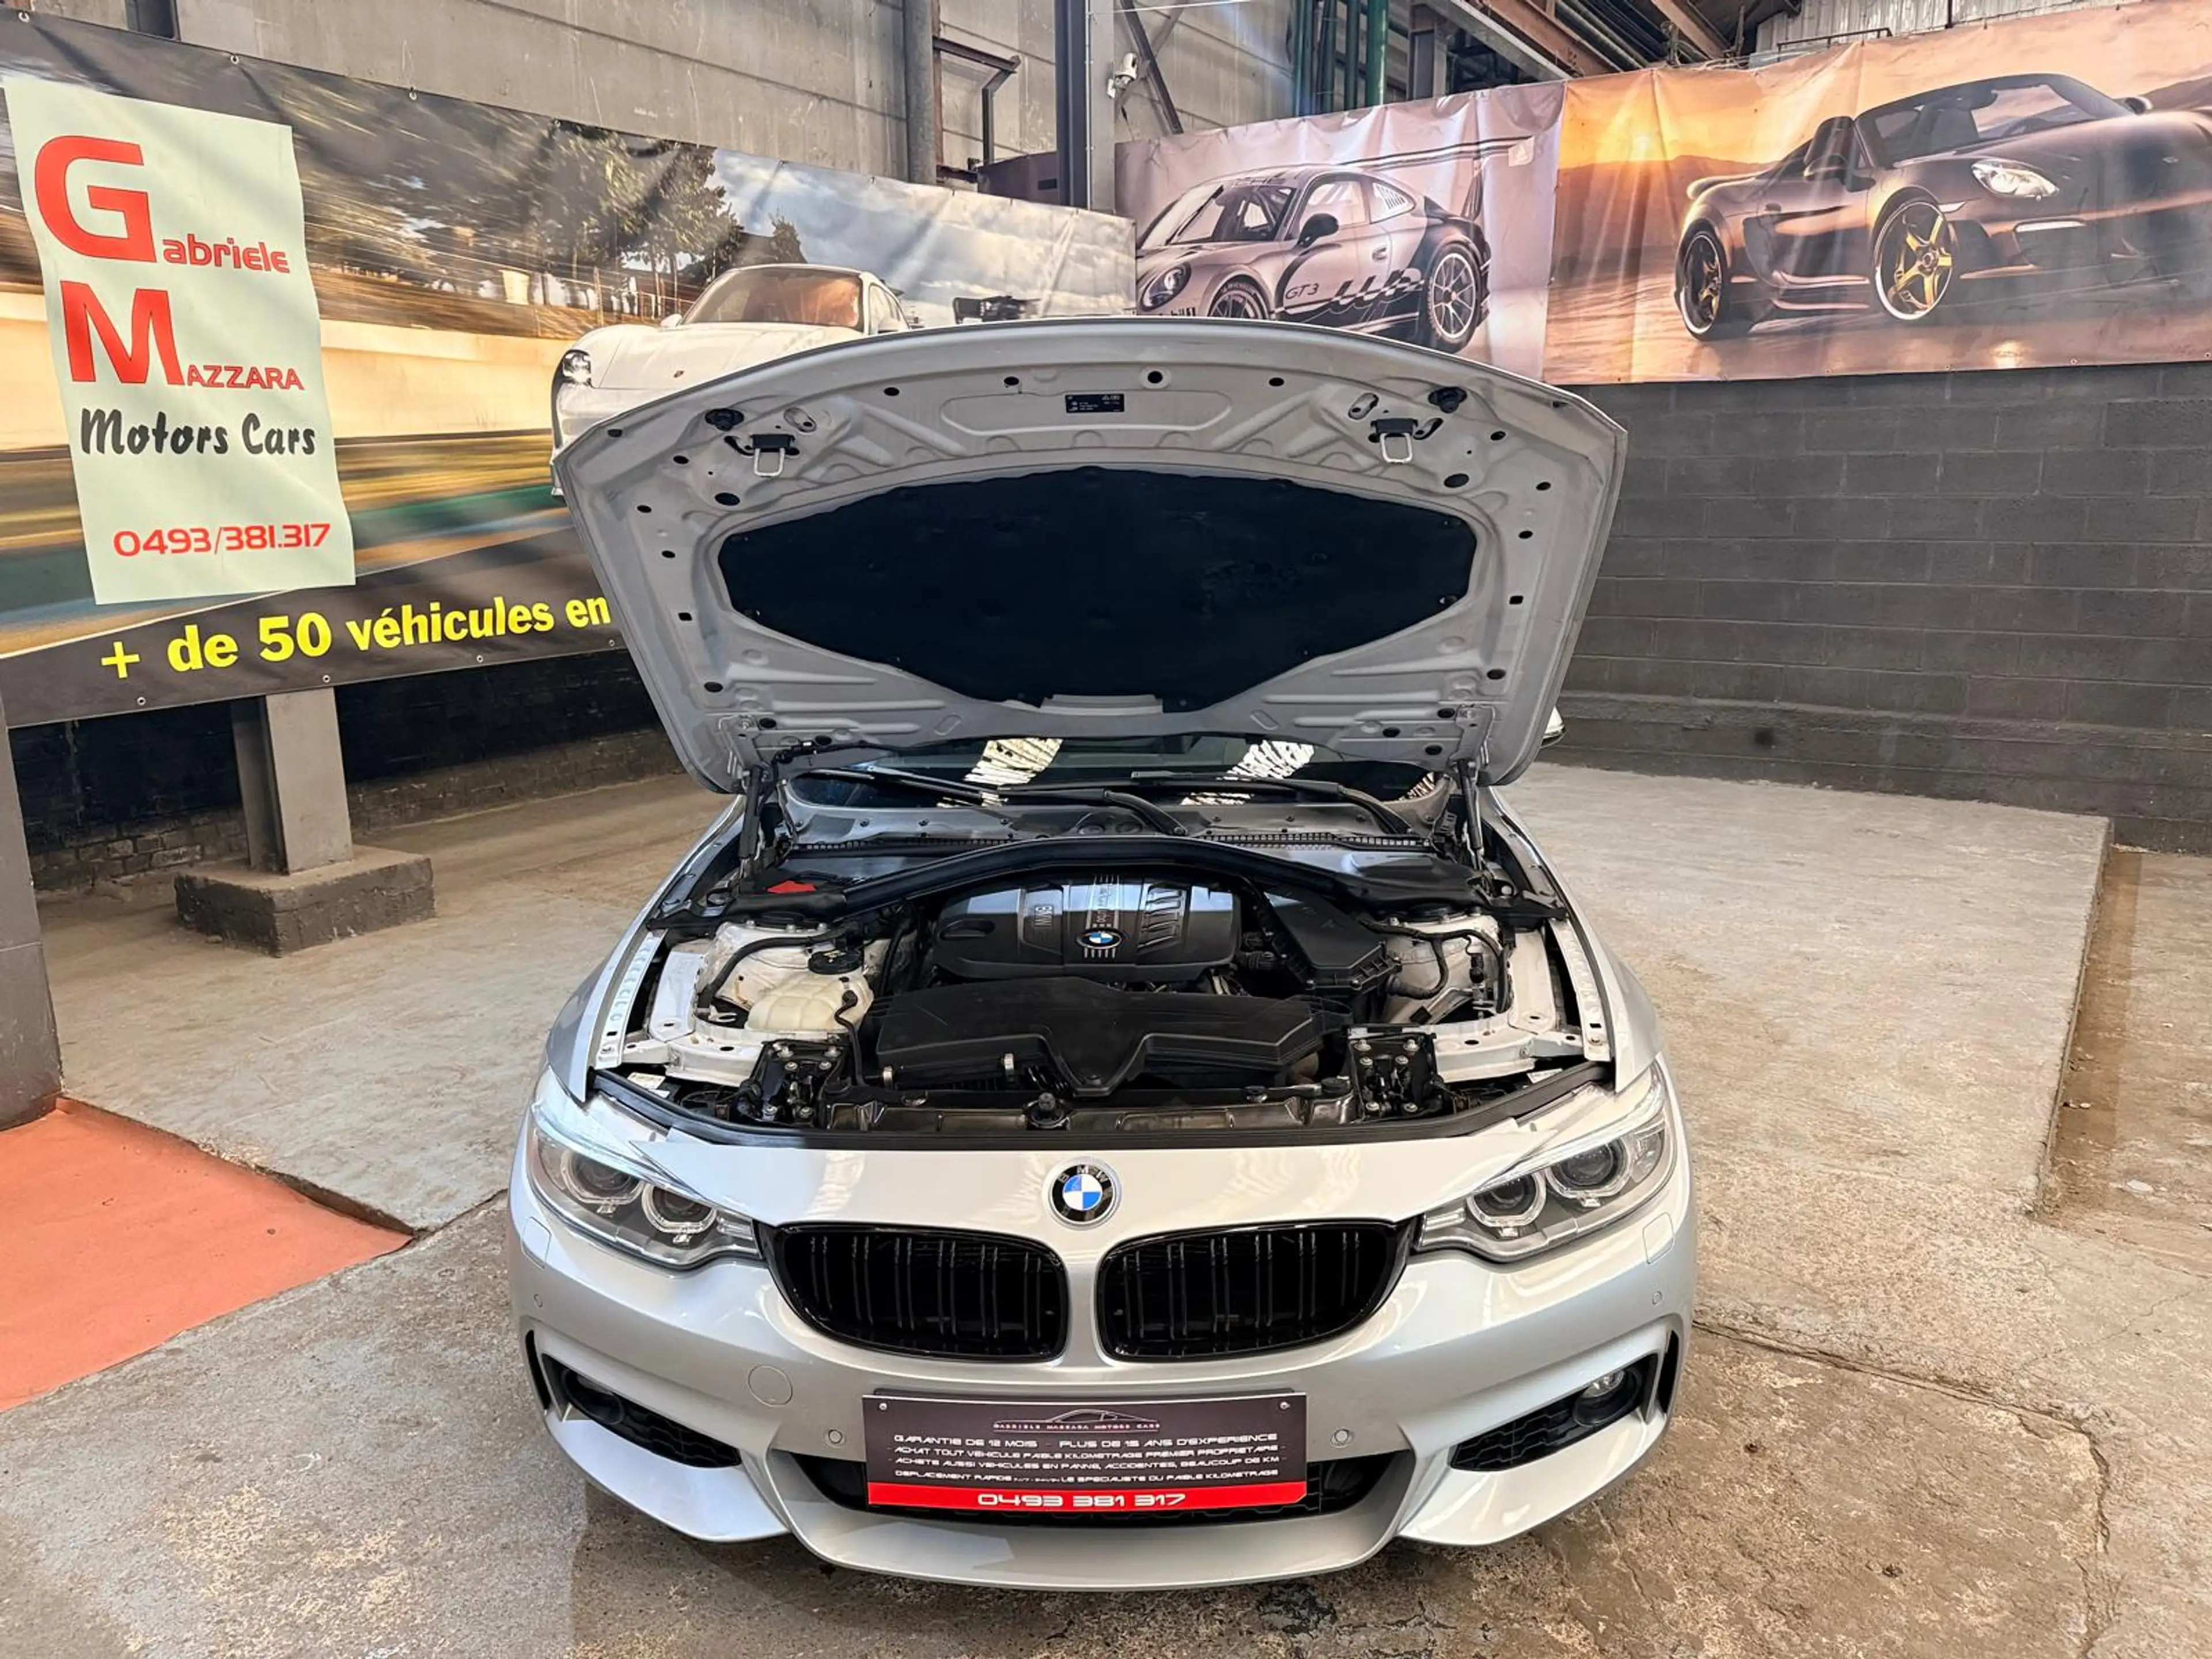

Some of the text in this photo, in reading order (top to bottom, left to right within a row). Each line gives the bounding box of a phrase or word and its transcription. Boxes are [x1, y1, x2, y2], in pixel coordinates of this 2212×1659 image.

[1285, 283, 1319, 300] GT3
[81, 408, 316, 455] Motors Cars
[112, 522, 332, 558] 0493/381.317
[101, 596, 609, 678] + de 50 véhicules en
[1057, 1165, 1109, 1184] BMW
[894, 1434, 962, 1446] GARANTIE
[965, 1438, 984, 1447] DE
[988, 1439, 1001, 1447] 12
[1005, 1439, 1038, 1448] MOIS
[1124, 1440, 1139, 1448] 15
[1143, 1438, 1173, 1447] ANS
[894, 1446, 931, 1455] ACHAT
[933, 1448, 965, 1456] TOUT
[966, 1449, 1021, 1459] VEHICULE
[1146, 1449, 1194, 1459] PREMIER
[1197, 1444, 1278, 1456] PROPRIETAIRE
[895, 1457, 940, 1466] ACHETE
[1180, 1458, 1243, 1468] BEAUCOUP
[1244, 1456, 1260, 1464] DE
[895, 1469, 971, 1481] DEPLACEMENT
[974, 1474, 1012, 1482] RAPIDE
[1077, 1475, 1146, 1483] SPECIALISTE
[1205, 1469, 1278, 1480] KILOMETRAGE
[977, 1493, 1186, 1507] 0493 381 317
